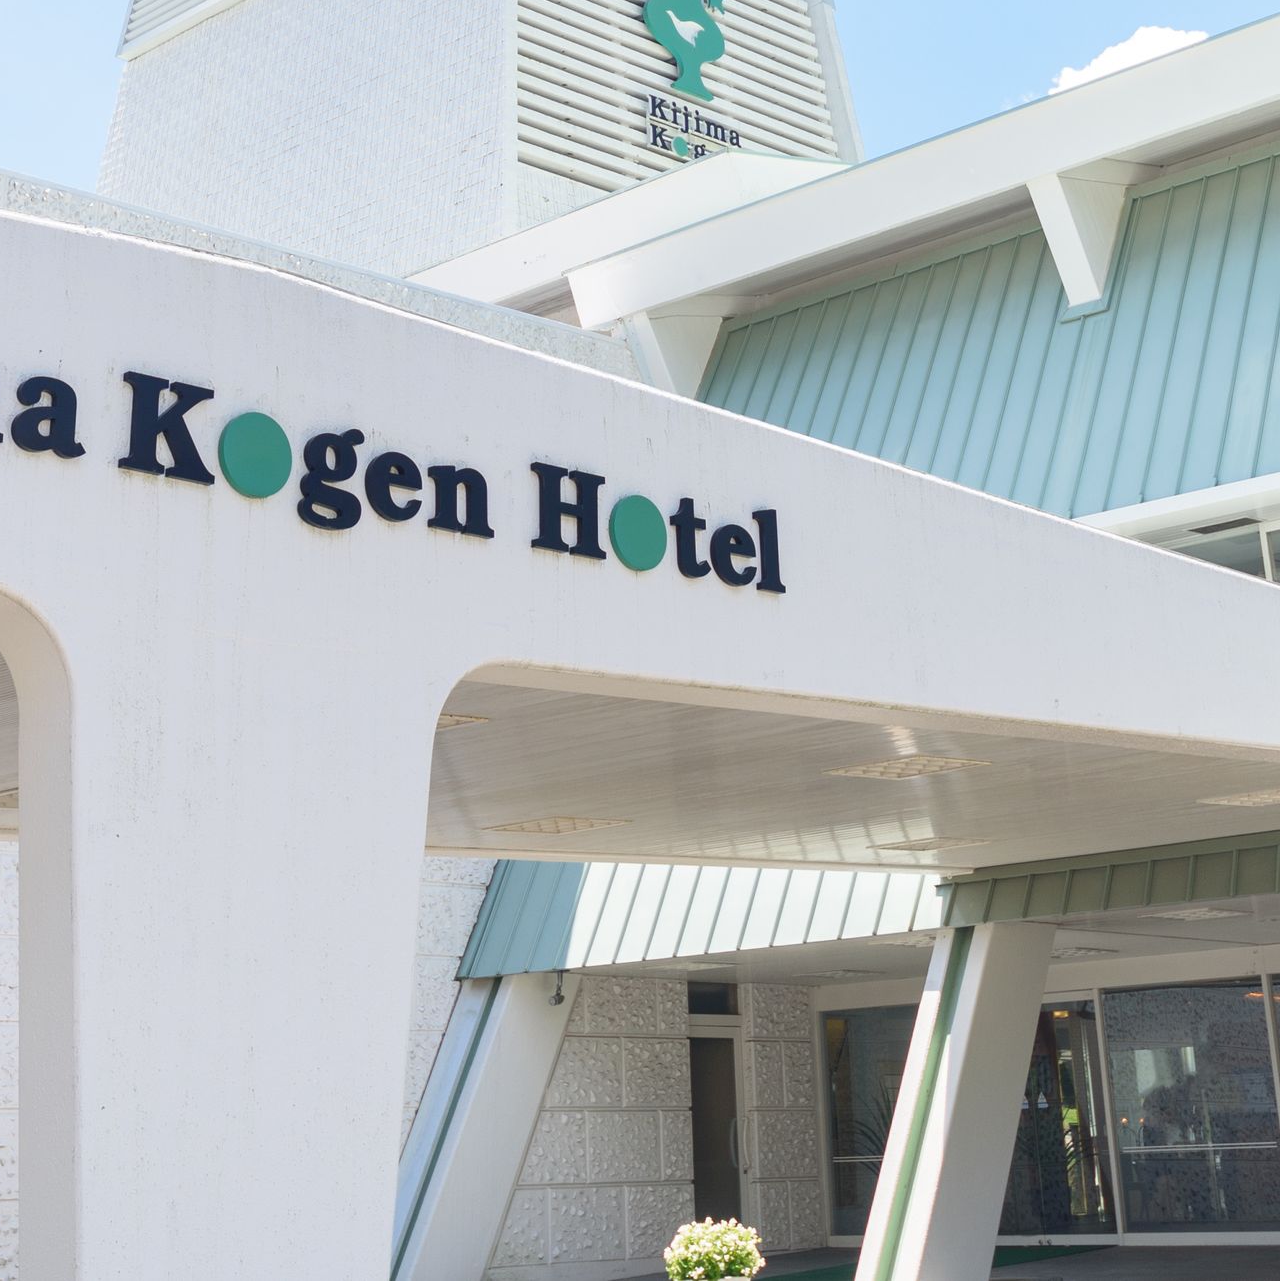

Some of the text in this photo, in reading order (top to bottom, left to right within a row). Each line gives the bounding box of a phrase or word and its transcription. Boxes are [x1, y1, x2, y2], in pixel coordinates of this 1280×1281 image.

[649, 94, 741, 148] Kijima
[117, 370, 495, 540] Kogen
[529, 461, 787, 594] Hotel
